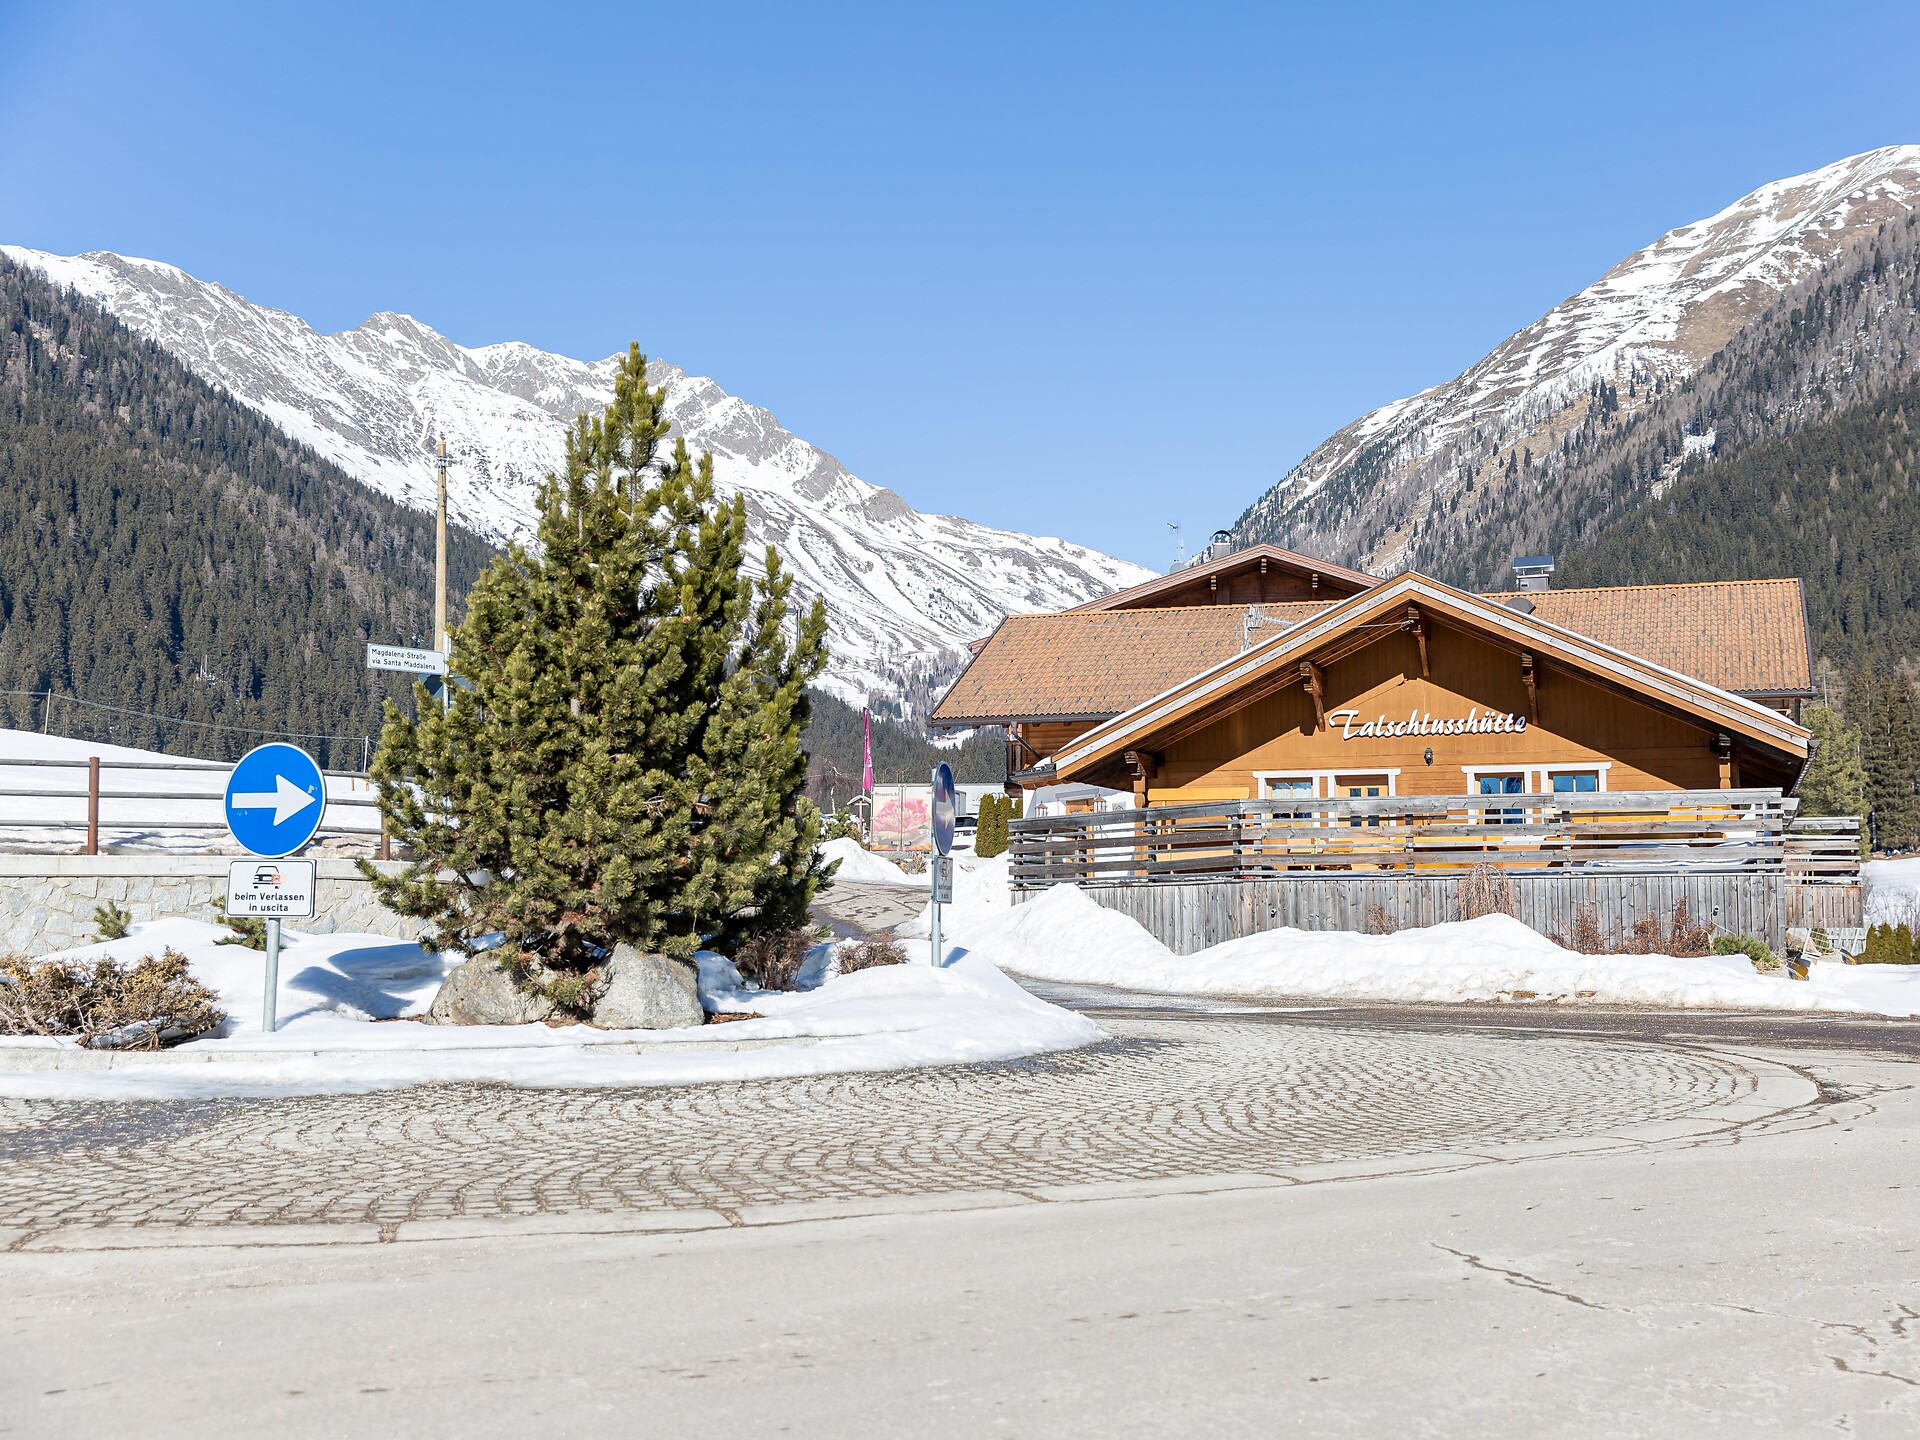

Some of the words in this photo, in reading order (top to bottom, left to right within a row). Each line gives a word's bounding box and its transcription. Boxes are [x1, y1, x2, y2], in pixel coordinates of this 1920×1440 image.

[383, 659, 402, 667] Santa
[403, 661, 436, 670] Maddalena
[1329, 707, 1527, 740] Talschlusshütte
[234, 892, 257, 901] beim
[259, 892, 305, 901] Verlassen
[248, 903, 258, 912] in
[260, 903, 289, 912] uscita
